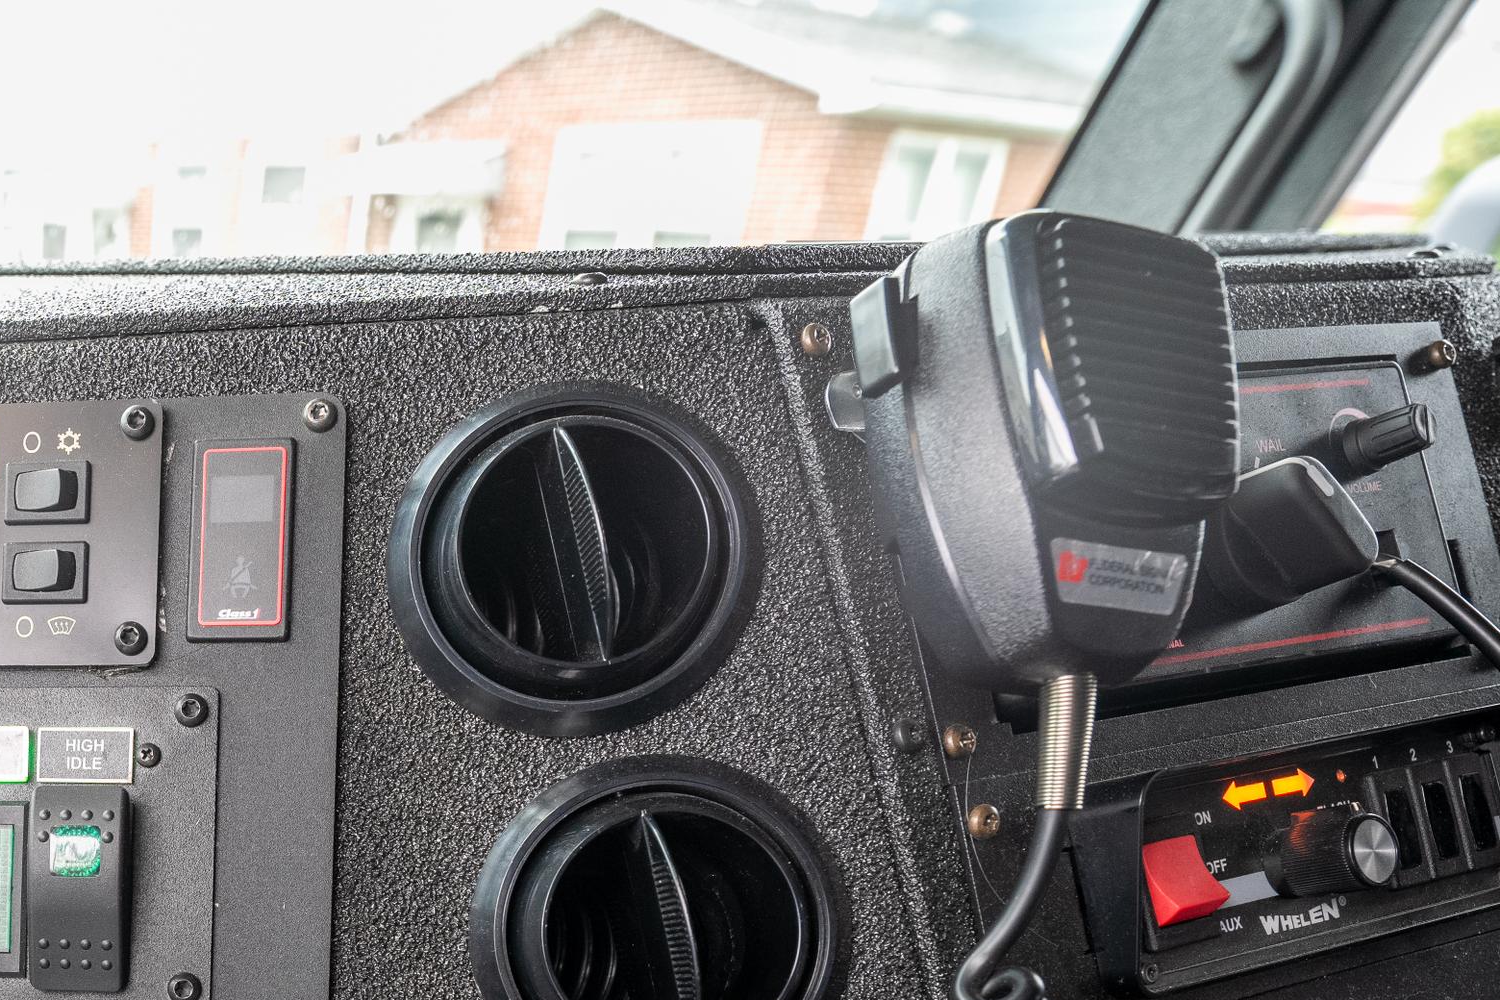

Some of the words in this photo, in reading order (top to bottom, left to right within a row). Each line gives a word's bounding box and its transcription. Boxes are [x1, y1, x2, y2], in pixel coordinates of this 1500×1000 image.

[1256, 438, 1286, 453] WAIL
[1346, 480, 1382, 493] VOLUME
[65, 739, 105, 753] HIGH
[1446, 740, 1454, 753] 3
[1409, 748, 1418, 761] 2
[66, 756, 103, 770] IDLE
[1372, 755, 1379, 769] 1
[1194, 810, 1212, 826] ON
[1206, 858, 1228, 875] OFF
[1219, 916, 1243, 934] AUX
